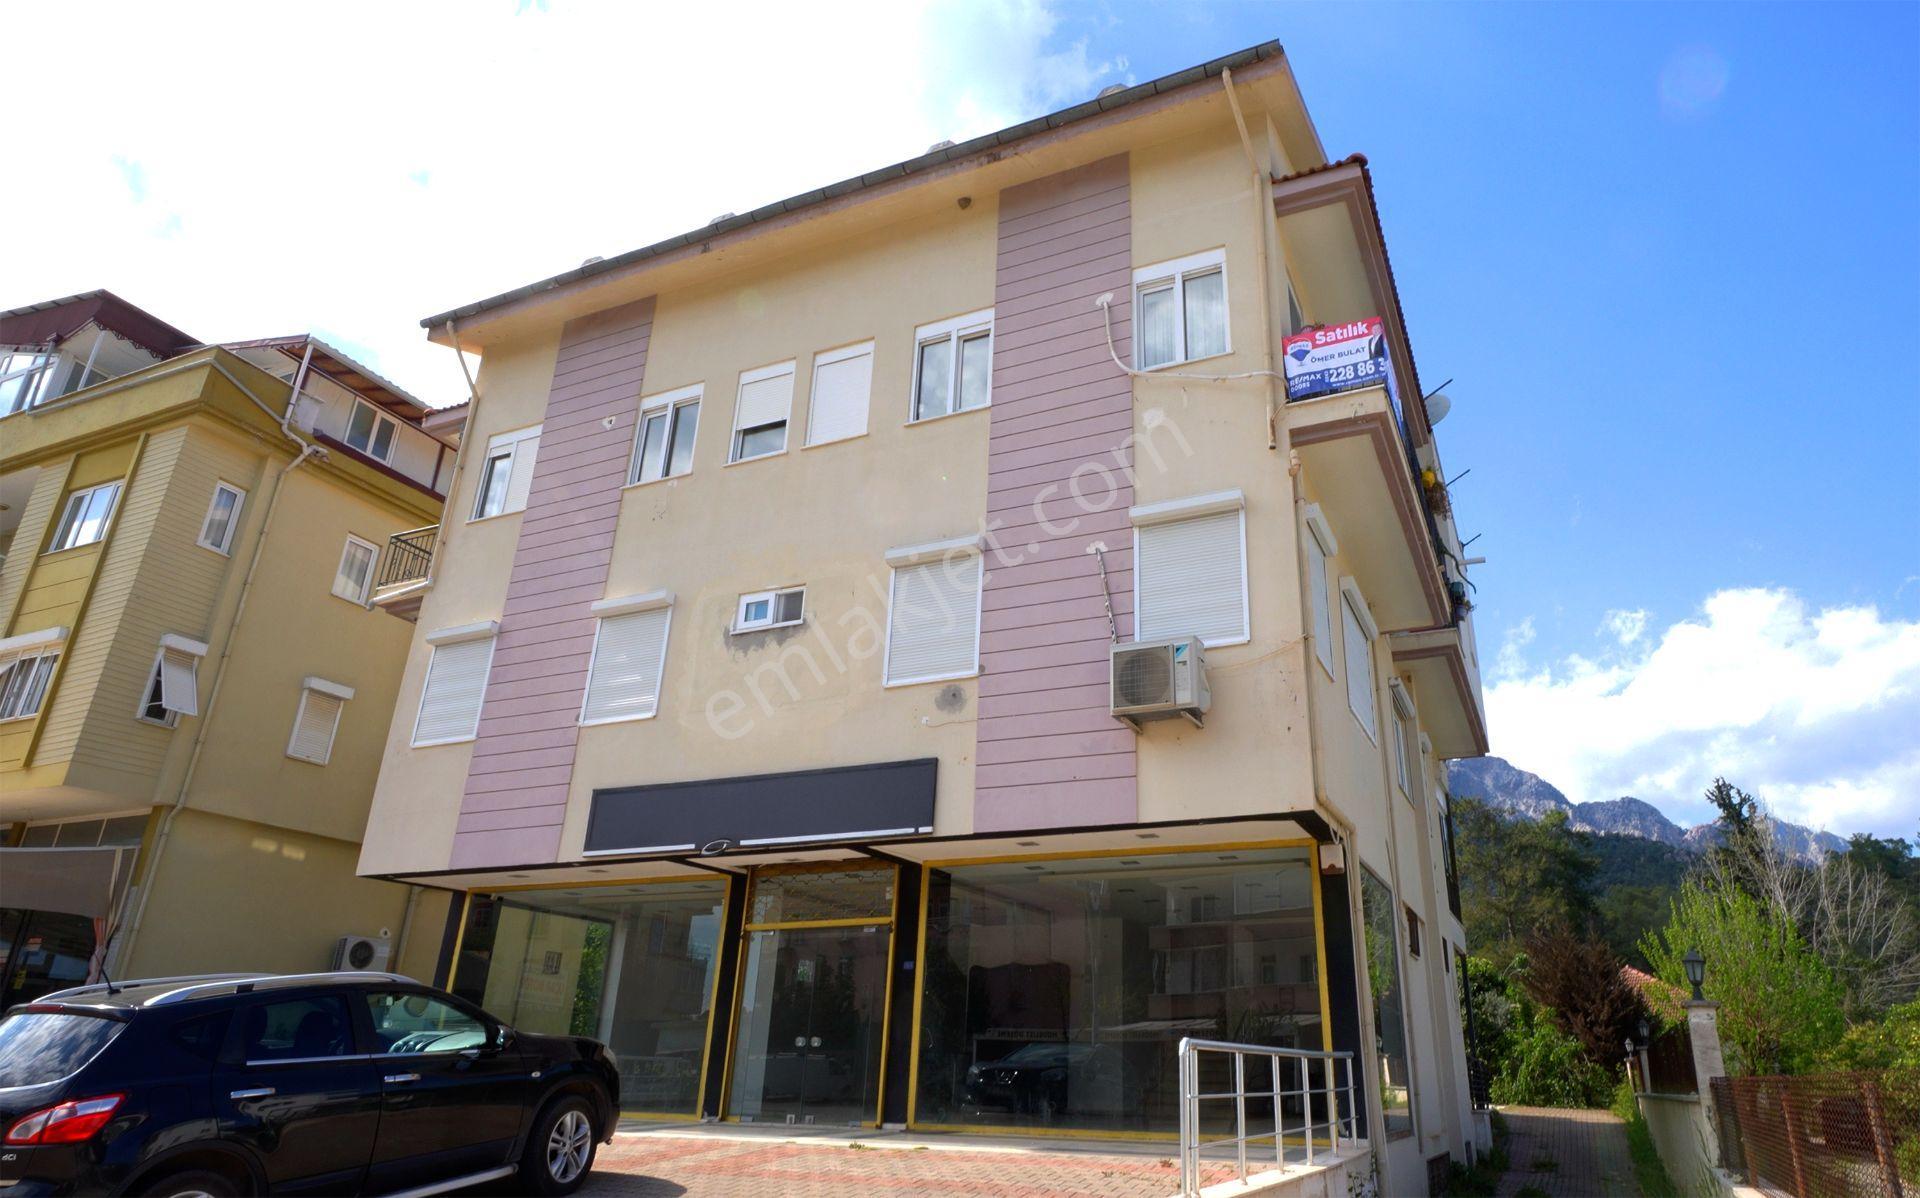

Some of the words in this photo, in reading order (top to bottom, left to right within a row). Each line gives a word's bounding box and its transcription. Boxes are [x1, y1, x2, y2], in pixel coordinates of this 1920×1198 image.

[1315, 321, 1369, 345] Satılık
[1290, 372, 1322, 387] RE/MAX
[1329, 365, 1355, 383] 228
[1357, 360, 1375, 377] 86
